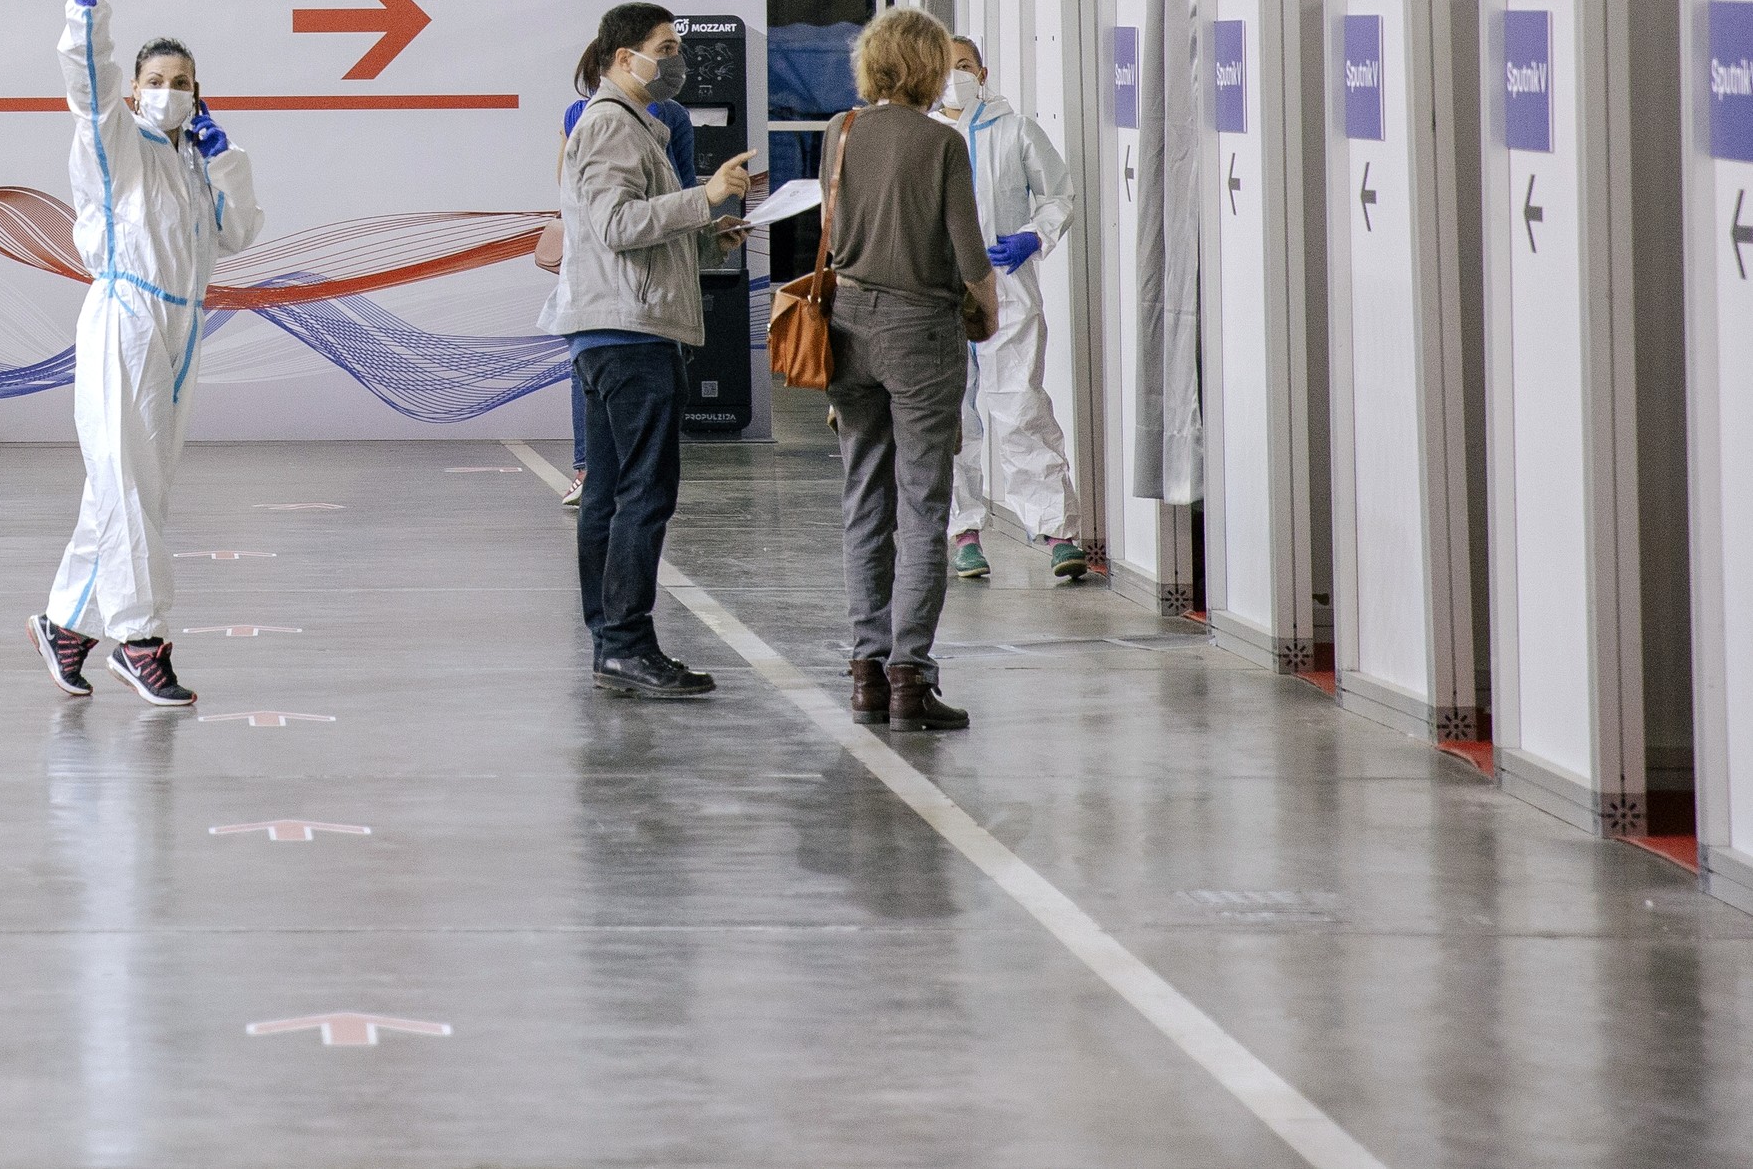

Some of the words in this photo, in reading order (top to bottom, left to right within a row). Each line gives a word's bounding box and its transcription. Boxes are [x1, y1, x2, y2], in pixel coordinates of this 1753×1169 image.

[691, 23, 737, 32] MOZZART
[1216, 61, 1237, 90] Sputnik
[1346, 60, 1373, 91] Sputnik
[1506, 60, 1538, 97] Sputnik
[1537, 62, 1547, 93] V
[1711, 58, 1751, 101] Sputnik
